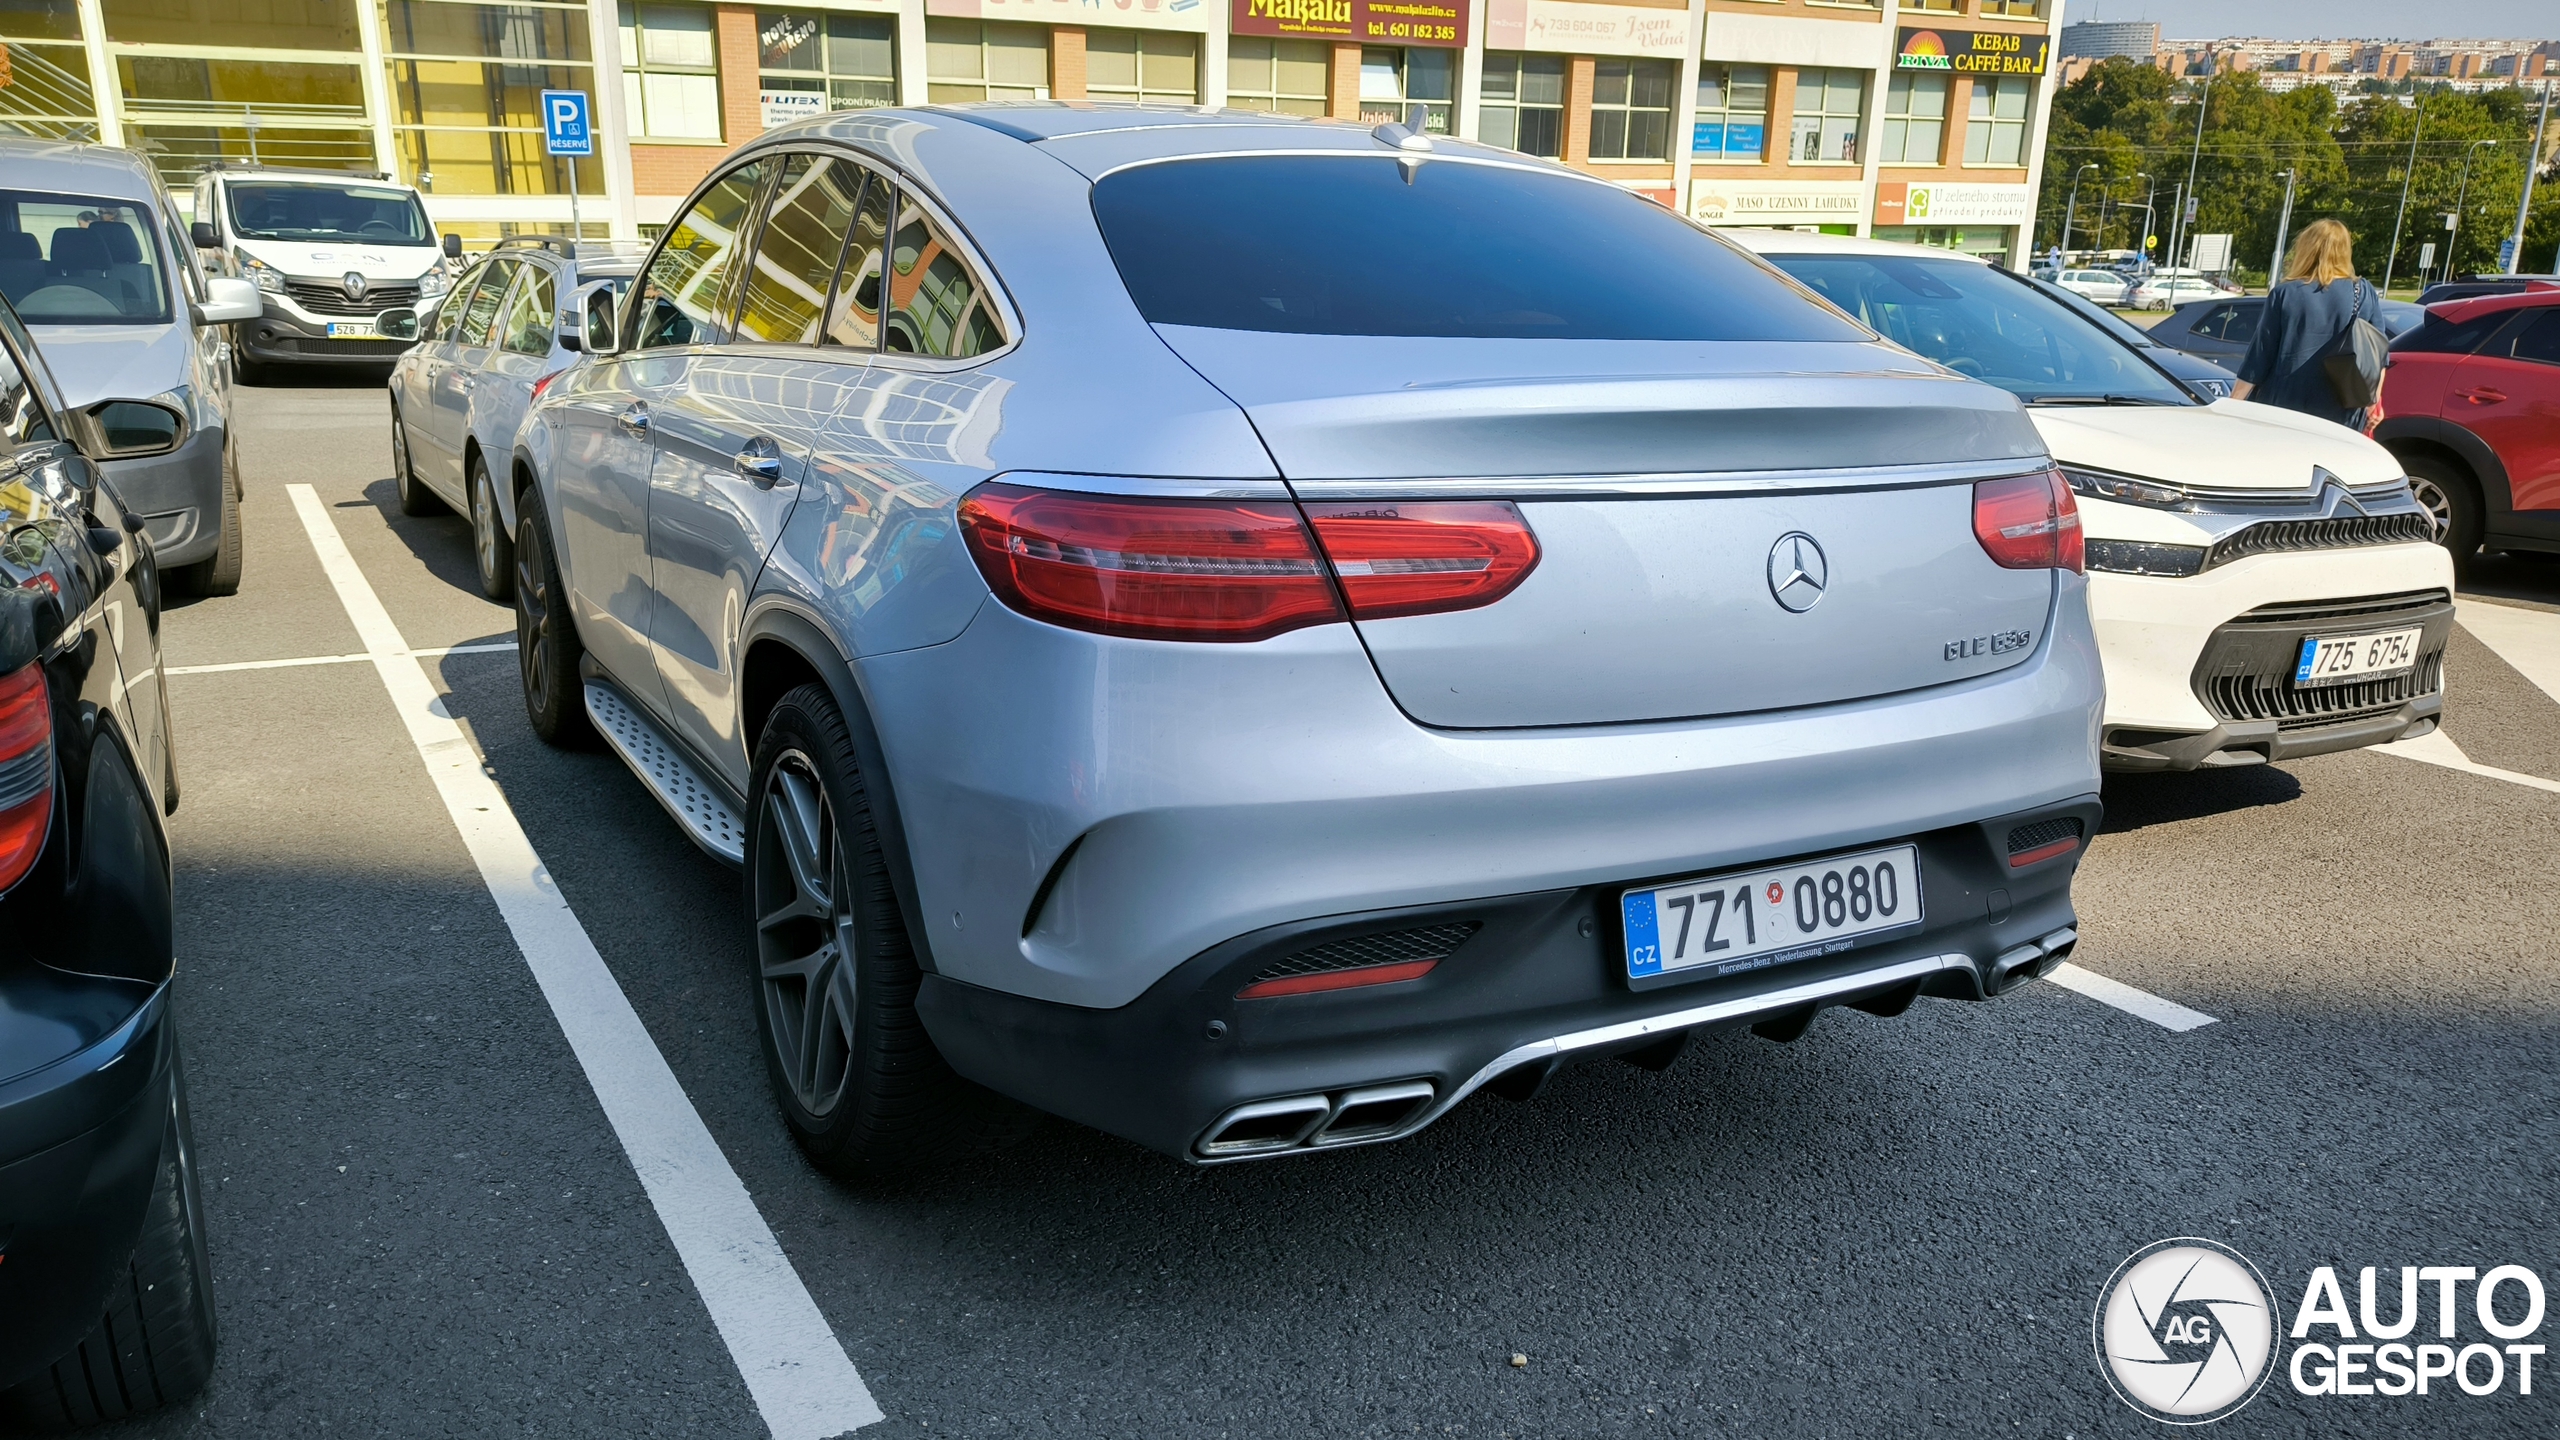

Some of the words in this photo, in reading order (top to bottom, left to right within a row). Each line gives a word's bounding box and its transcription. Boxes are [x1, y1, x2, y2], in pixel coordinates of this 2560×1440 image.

[1247, 0, 1352, 27] Makalu
[761, 14, 793, 47] NOVĚ
[1368, 21, 1387, 36] tel.
[1390, 22, 1410, 37] 601
[1413, 24, 1432, 39] 182
[1434, 25, 1456, 40] 385
[1550, 18, 1570, 31] 739
[1573, 20, 1593, 32] 604
[1596, 21, 1616, 34] 067
[1624, 15, 1671, 38] Jsem
[1638, 31, 1684, 48] Volná
[1972, 34, 2020, 51] KEBAB
[1902, 55, 1948, 67] RIVA
[1955, 52, 2001, 72] CAFFÉ
[2003, 57, 2031, 73] BAR
[775, 96, 820, 106] LITEX
[831, 96, 863, 106] SPODNÍ
[552, 99, 579, 135] P
[1361, 111, 1394, 123] Italské
[1736, 196, 1763, 209] MASO
[1769, 197, 1810, 209] UZENINY
[1815, 193, 1859, 209] LAHŮDKY
[1935, 189, 1943, 202] U
[1945, 189, 1989, 203] zeleného
[1993, 192, 2026, 203] stromu
[1699, 211, 1724, 219] SINGER
[1933, 205, 1976, 217] přírodní
[1980, 208, 2023, 217] produkty
[336, 326, 356, 335] 5Z8
[1944, 636, 1987, 661] GLE
[2315, 641, 2357, 674] 7Z5
[2367, 634, 2412, 668] 6754
[2299, 665, 2311, 675] CZ
[1667, 884, 1756, 960] 7Z1
[1793, 860, 1898, 933] 0880
[1632, 945, 1657, 965] CZ
[1718, 956, 1771, 975] Mercedes-Benz
[1774, 946, 1823, 964] Niederlassung
[1825, 940, 1854, 954] Stuttgart
